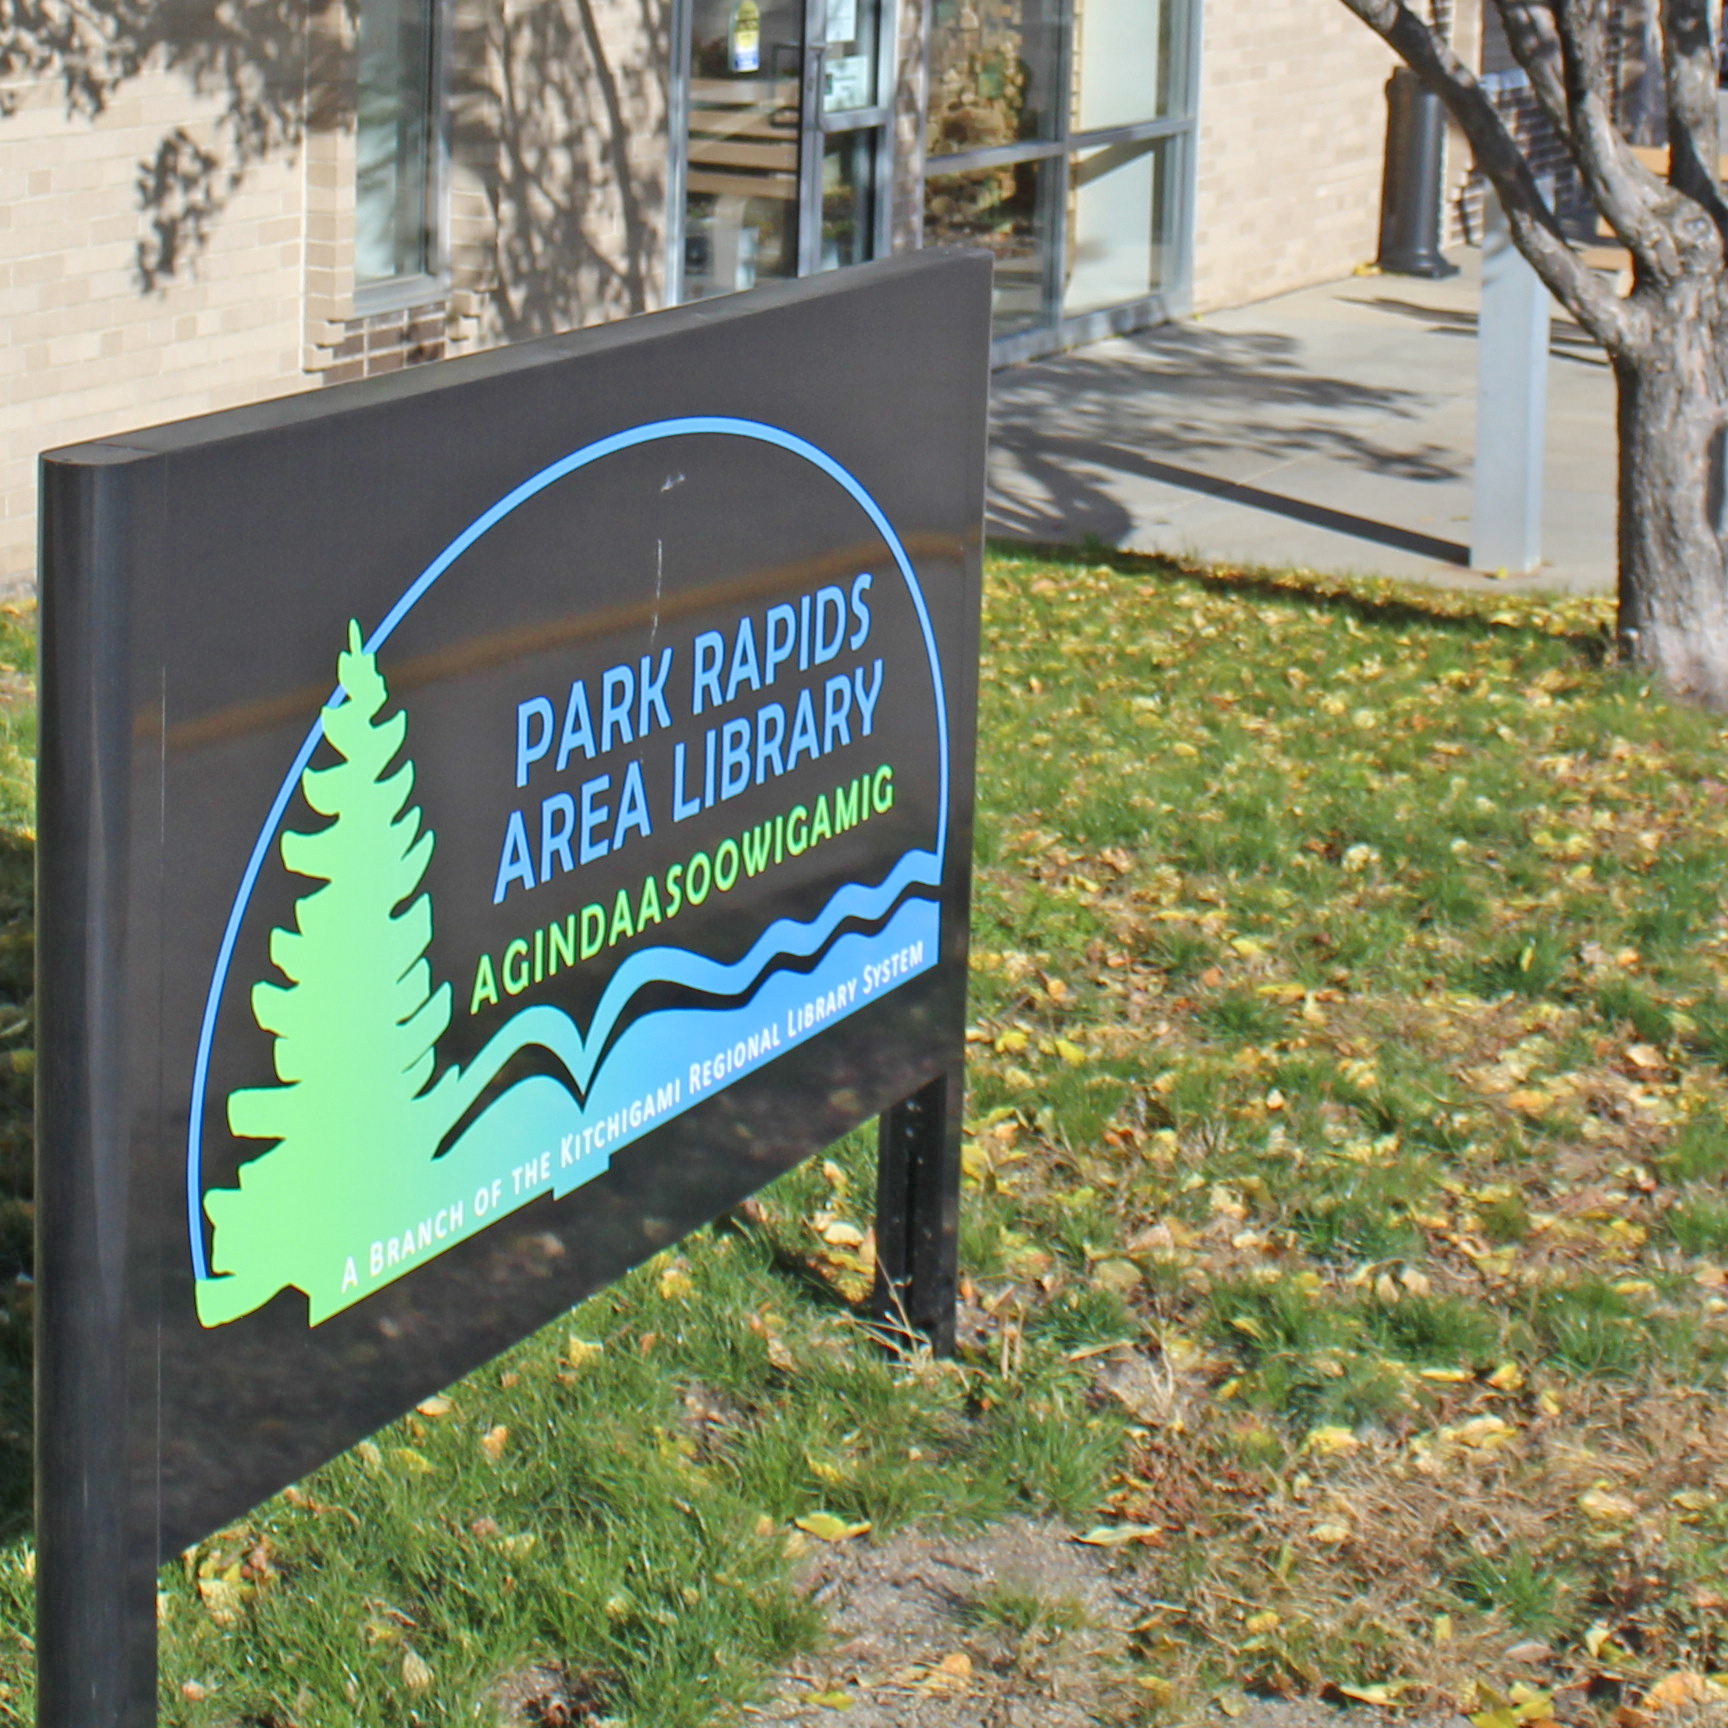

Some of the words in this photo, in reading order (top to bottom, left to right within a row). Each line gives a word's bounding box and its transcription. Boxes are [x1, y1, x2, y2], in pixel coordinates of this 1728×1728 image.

[493, 761, 652, 904] AREA
[674, 659, 884, 822] LIBRARY
[516, 647, 672, 788] PARK
[692, 573, 873, 715] RAPIDS
[470, 764, 895, 1015] AGINDAASOOWIGAMIG
[341, 1256, 359, 1293] A
[369, 1200, 464, 1277] BRANCH
[474, 1178, 502, 1217] OF
[511, 1151, 551, 1195] THE
[560, 1078, 681, 1168] KITCHIGAMI
[689, 1024, 781, 1095] REGIONAL
[787, 978, 857, 1038] LIBRARY
[862, 940, 924, 994] SYSTEM
